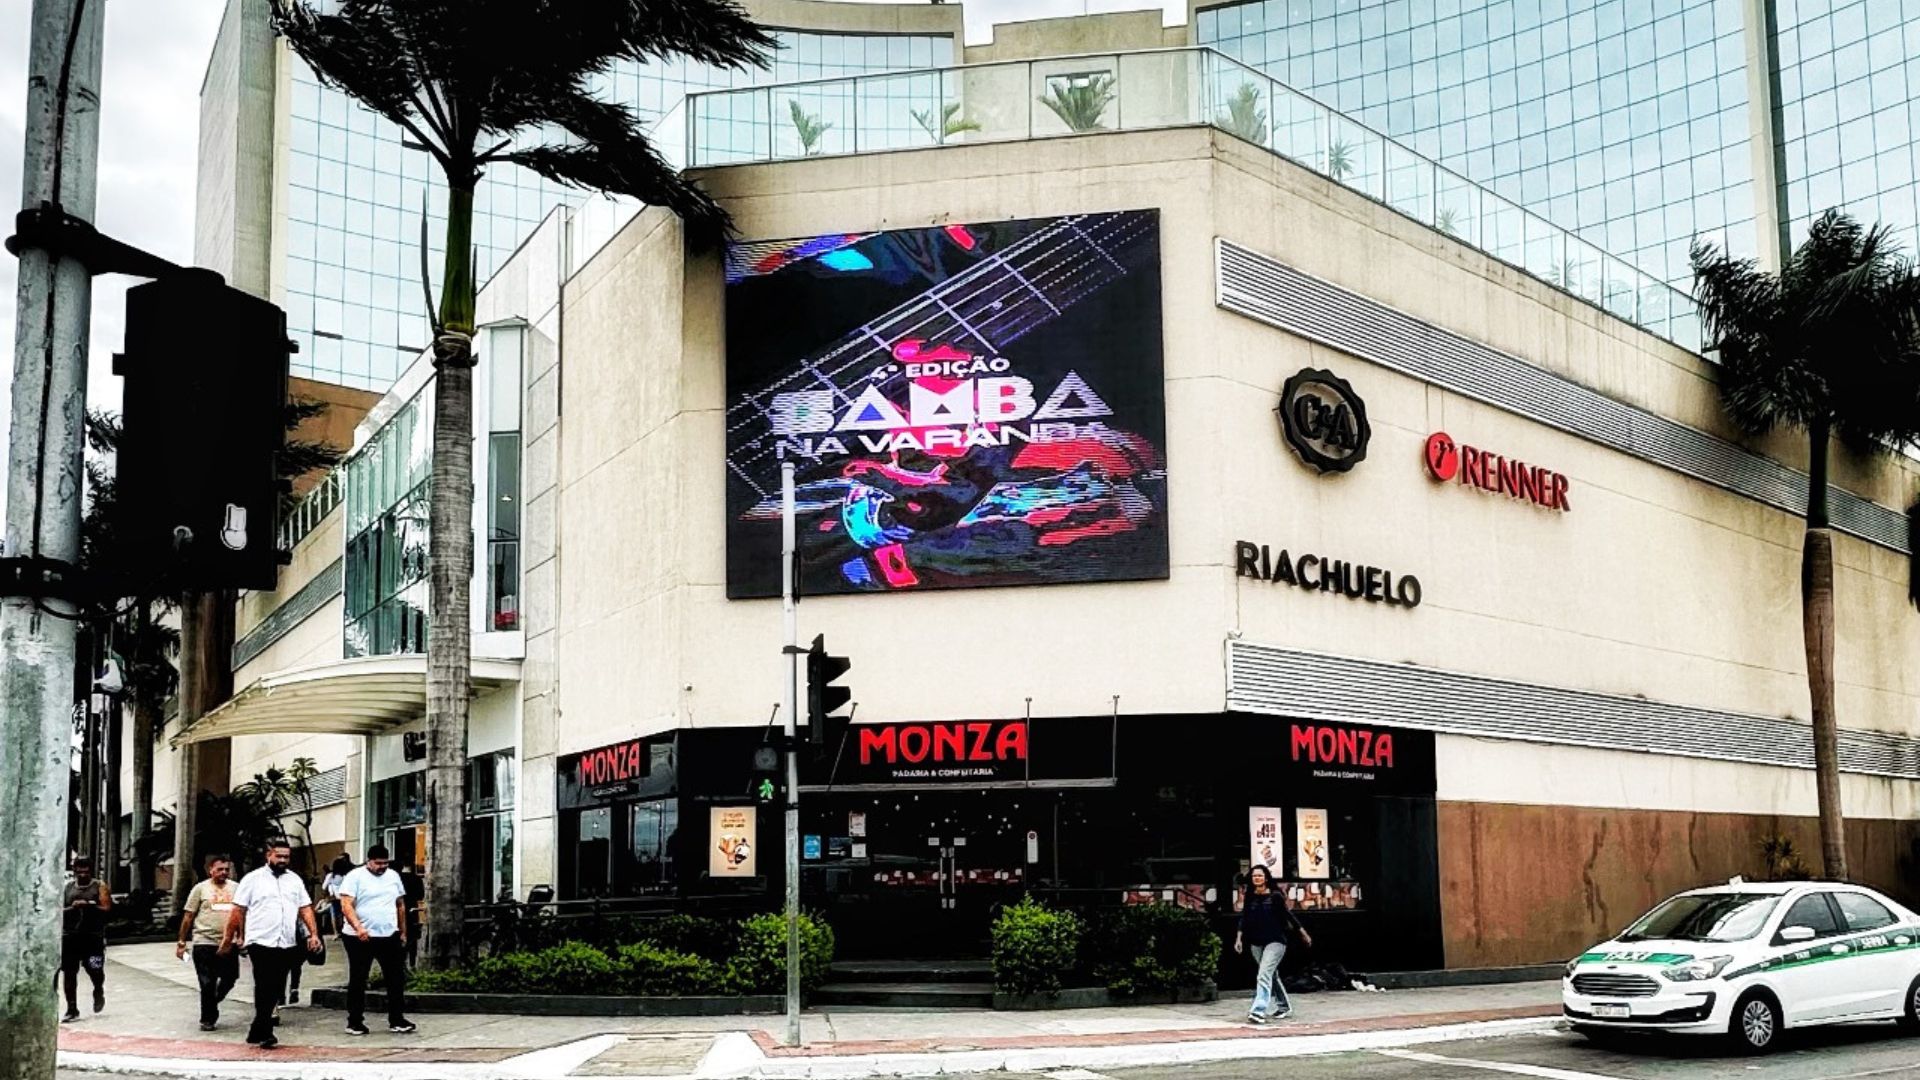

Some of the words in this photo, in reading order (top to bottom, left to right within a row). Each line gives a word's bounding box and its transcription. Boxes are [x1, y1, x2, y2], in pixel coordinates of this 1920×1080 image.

[905, 357, 1010, 378] EDIÇÃO
[767, 369, 1114, 435] SAMBA
[1293, 393, 1357, 450] C&A
[776, 436, 849, 459] NA
[1462, 444, 1571, 512] RENNER
[1236, 540, 1422, 609] RIACHUELO
[581, 742, 640, 787] MONZA
[859, 722, 1028, 765] MONZA
[1291, 724, 1393, 768] MONZA
